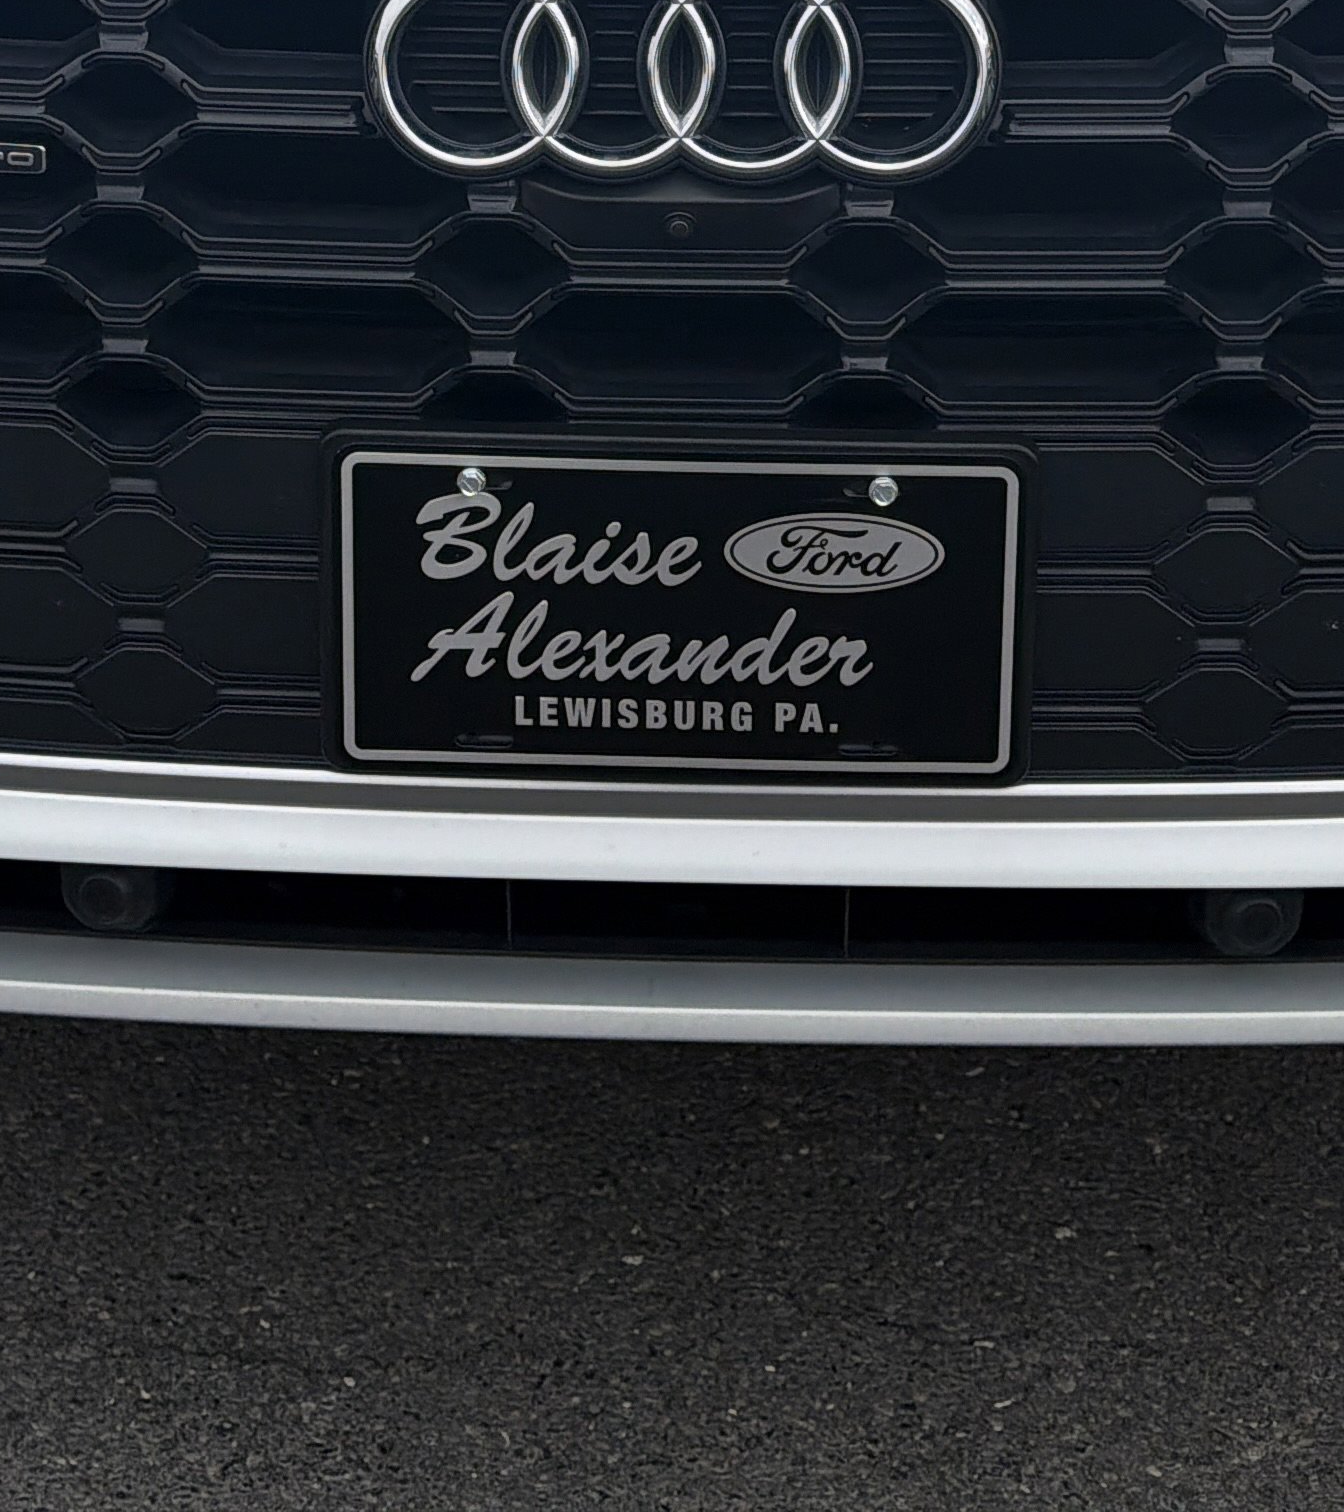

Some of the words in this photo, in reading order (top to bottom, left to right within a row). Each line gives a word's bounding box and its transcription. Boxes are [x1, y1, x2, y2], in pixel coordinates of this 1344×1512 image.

[416, 491, 702, 586] Blaise
[766, 525, 902, 578] Ford
[410, 591, 874, 687] Alexander
[514, 695, 753, 732] LEWISBURG
[774, 702, 839, 733] PA.
